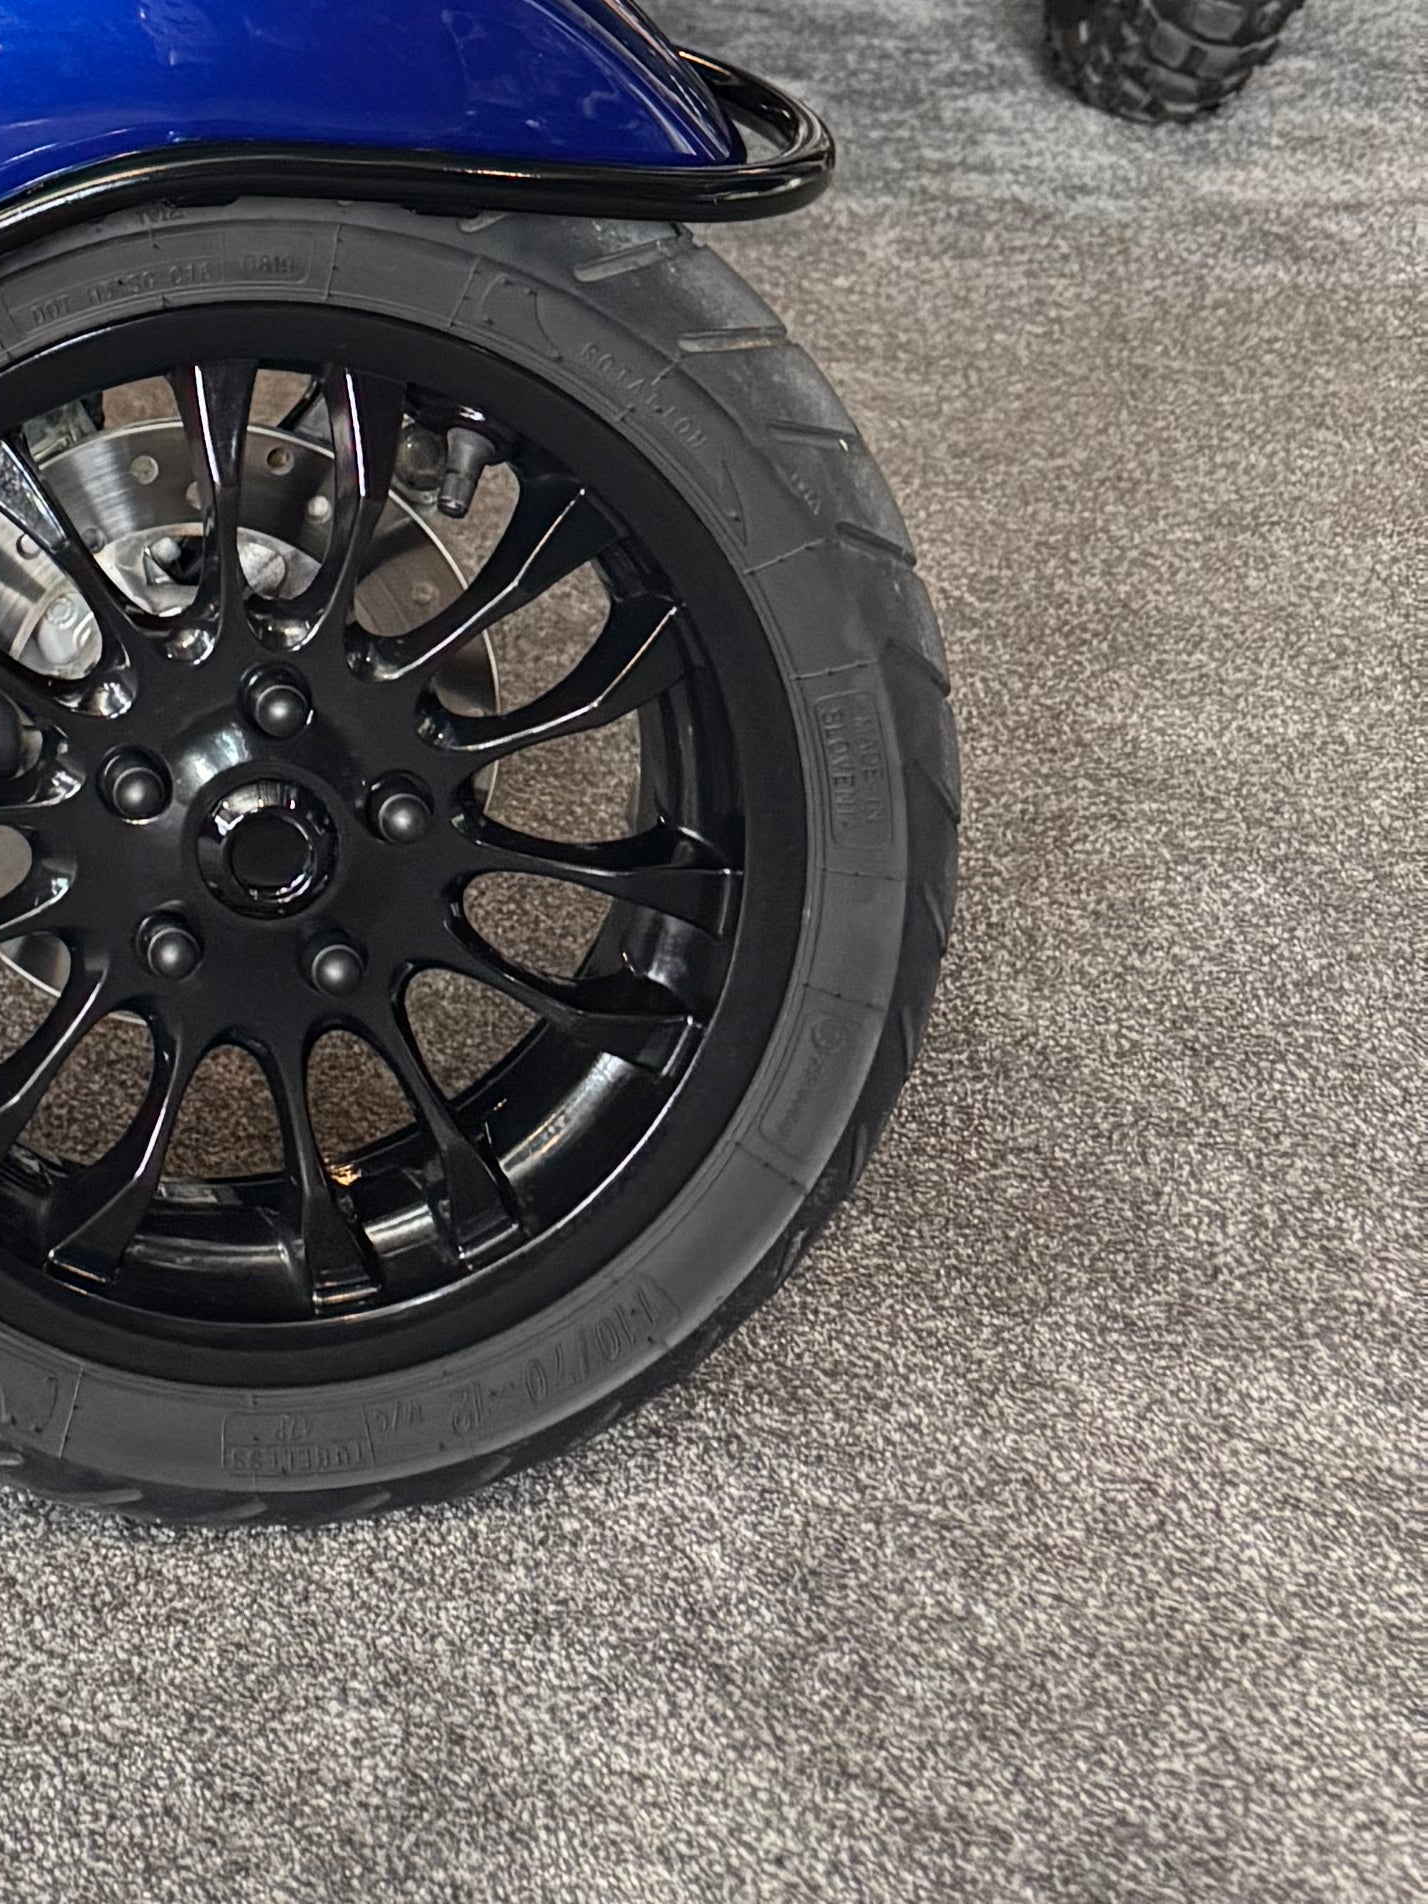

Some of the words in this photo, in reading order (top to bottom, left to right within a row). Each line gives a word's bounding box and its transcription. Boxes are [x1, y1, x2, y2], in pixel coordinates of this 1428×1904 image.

[580, 340, 708, 449] ROTATION
[853, 714, 882, 782] MADE
[864, 797, 887, 822] IN
